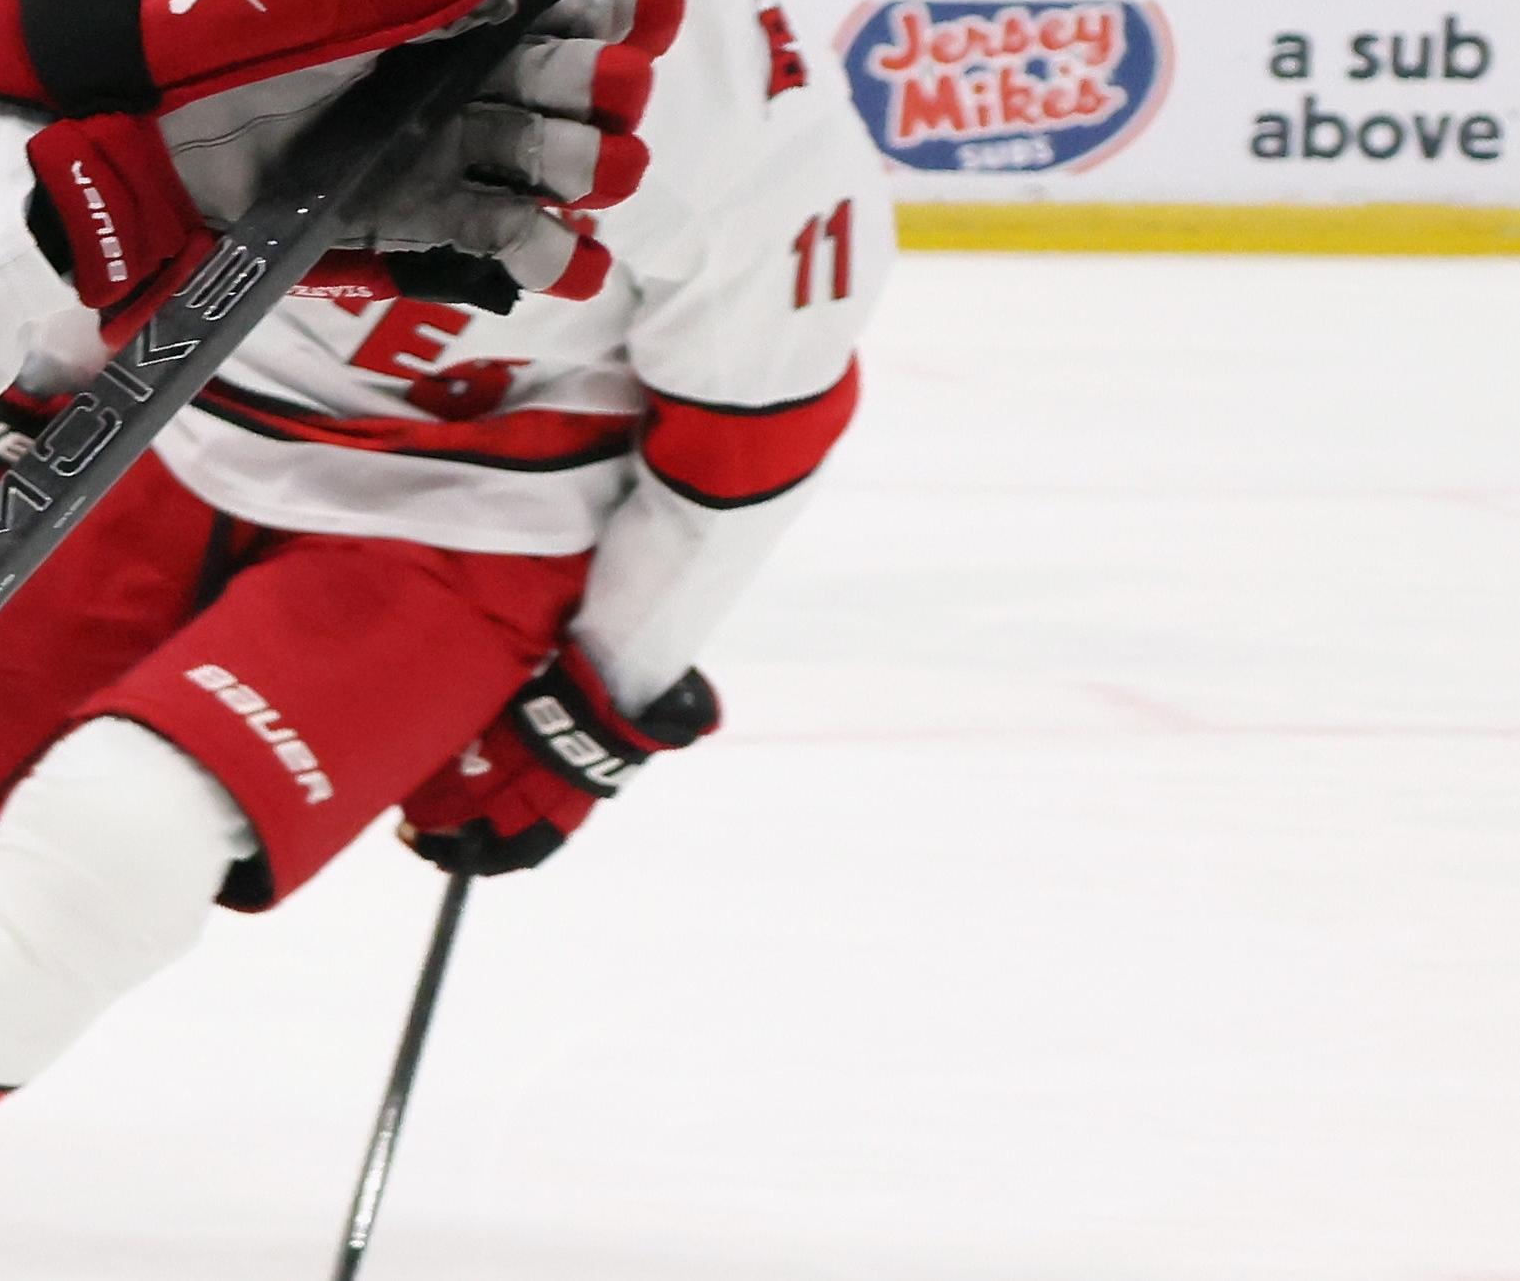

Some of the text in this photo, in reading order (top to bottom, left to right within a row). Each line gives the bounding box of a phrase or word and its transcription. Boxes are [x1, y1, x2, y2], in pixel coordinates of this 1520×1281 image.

[879, 12, 1113, 70] Jersey
[1268, 13, 1491, 80] a sub
[1250, 94, 1502, 160] above
[790, 198, 854, 310] 11
